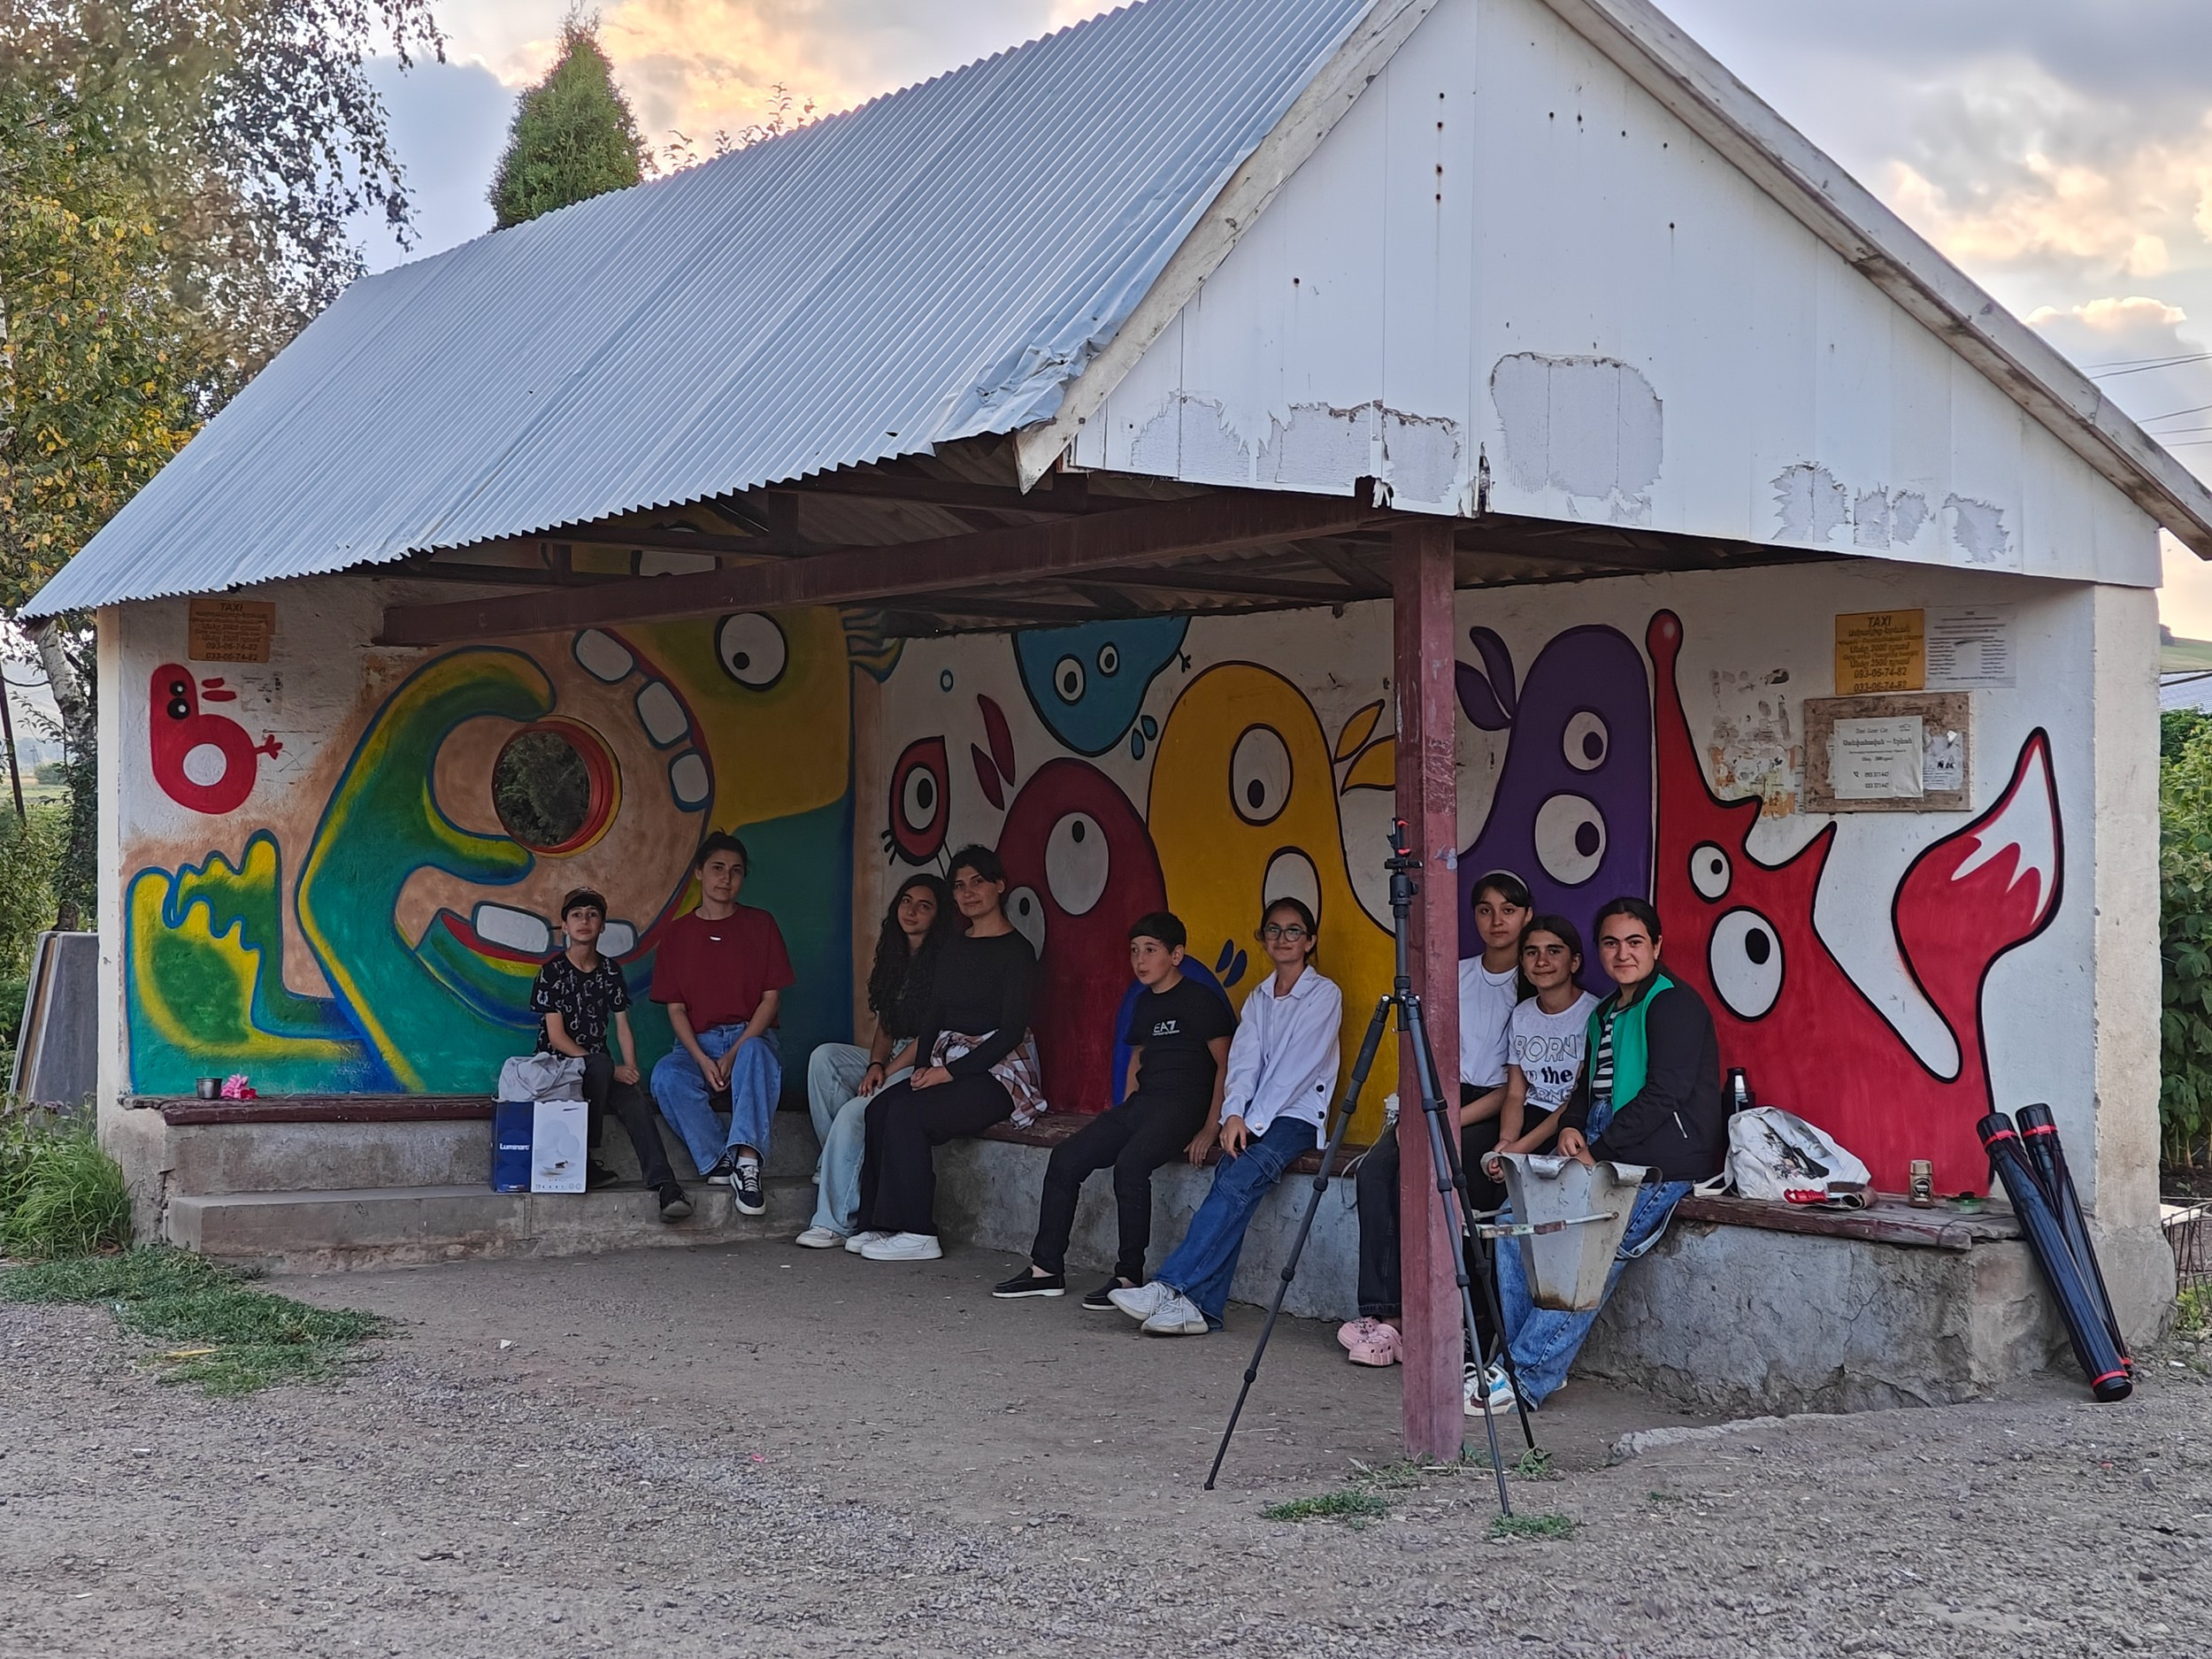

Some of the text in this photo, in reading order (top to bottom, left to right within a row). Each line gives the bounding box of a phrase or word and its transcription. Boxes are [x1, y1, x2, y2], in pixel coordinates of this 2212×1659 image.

[219, 603, 243, 612] TAXI
[1868, 616, 1892, 627] TAXI
[1855, 667, 1907, 679] 093-06-74-82
[1854, 680, 1907, 692] 033-06-74-82
[1153, 1020, 1177, 1033] EA7
[1514, 1034, 1578, 1063] BORN
[1540, 1066, 1574, 1085] the
[499, 1142, 530, 1151] Luminarc
